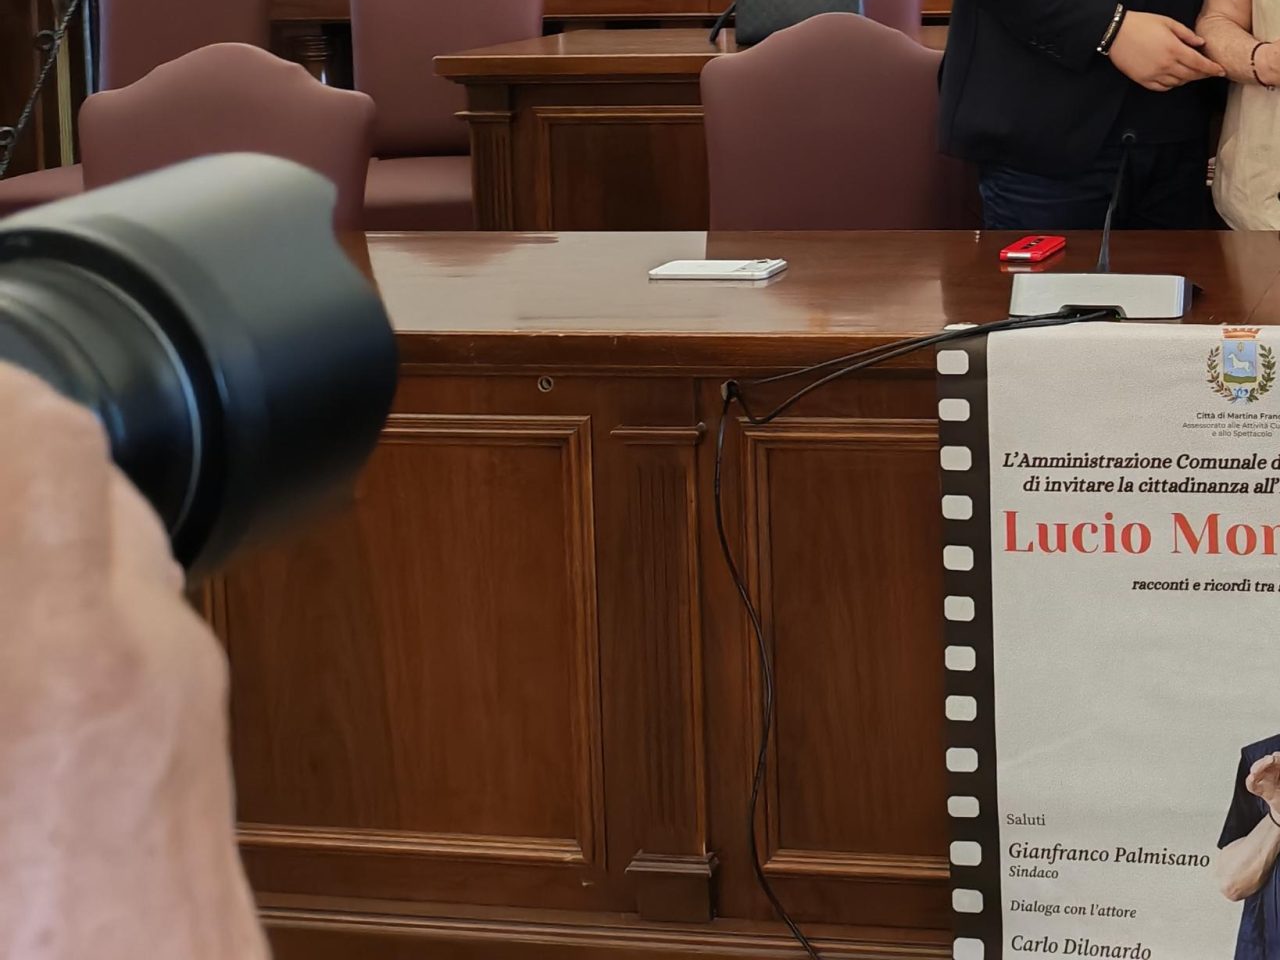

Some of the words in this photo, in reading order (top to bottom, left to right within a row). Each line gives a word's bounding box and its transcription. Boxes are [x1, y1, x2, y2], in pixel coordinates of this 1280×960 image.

[1196, 412, 1215, 420] Città
[1218, 412, 1225, 420] di
[1227, 412, 1258, 420] Martina
[1233, 430, 1273, 439] Spettacolo
[1002, 451, 1173, 469] L’Amministrazione
[1176, 452, 1268, 470] Comunale
[1023, 475, 1040, 492] di
[1044, 476, 1115, 493] invitare
[1119, 476, 1134, 493] la
[1138, 476, 1250, 494] cittadinanza
[1002, 510, 1152, 555] Lucio
[1131, 578, 1190, 591] racconti
[1192, 582, 1201, 591] e
[1203, 579, 1251, 592] ricordi
[1254, 581, 1275, 593] tra
[1006, 813, 1046, 826] Saluti
[1008, 842, 1110, 865] Gianfranco
[1113, 846, 1211, 868] Palmisano
[1008, 865, 1059, 879] Sindaco
[1010, 899, 1061, 917] Dialoga
[1063, 904, 1087, 916] con
[1090, 903, 1138, 919] l’attore
[1011, 935, 1059, 954] Carlo
[1062, 938, 1152, 960] Dilonardo
